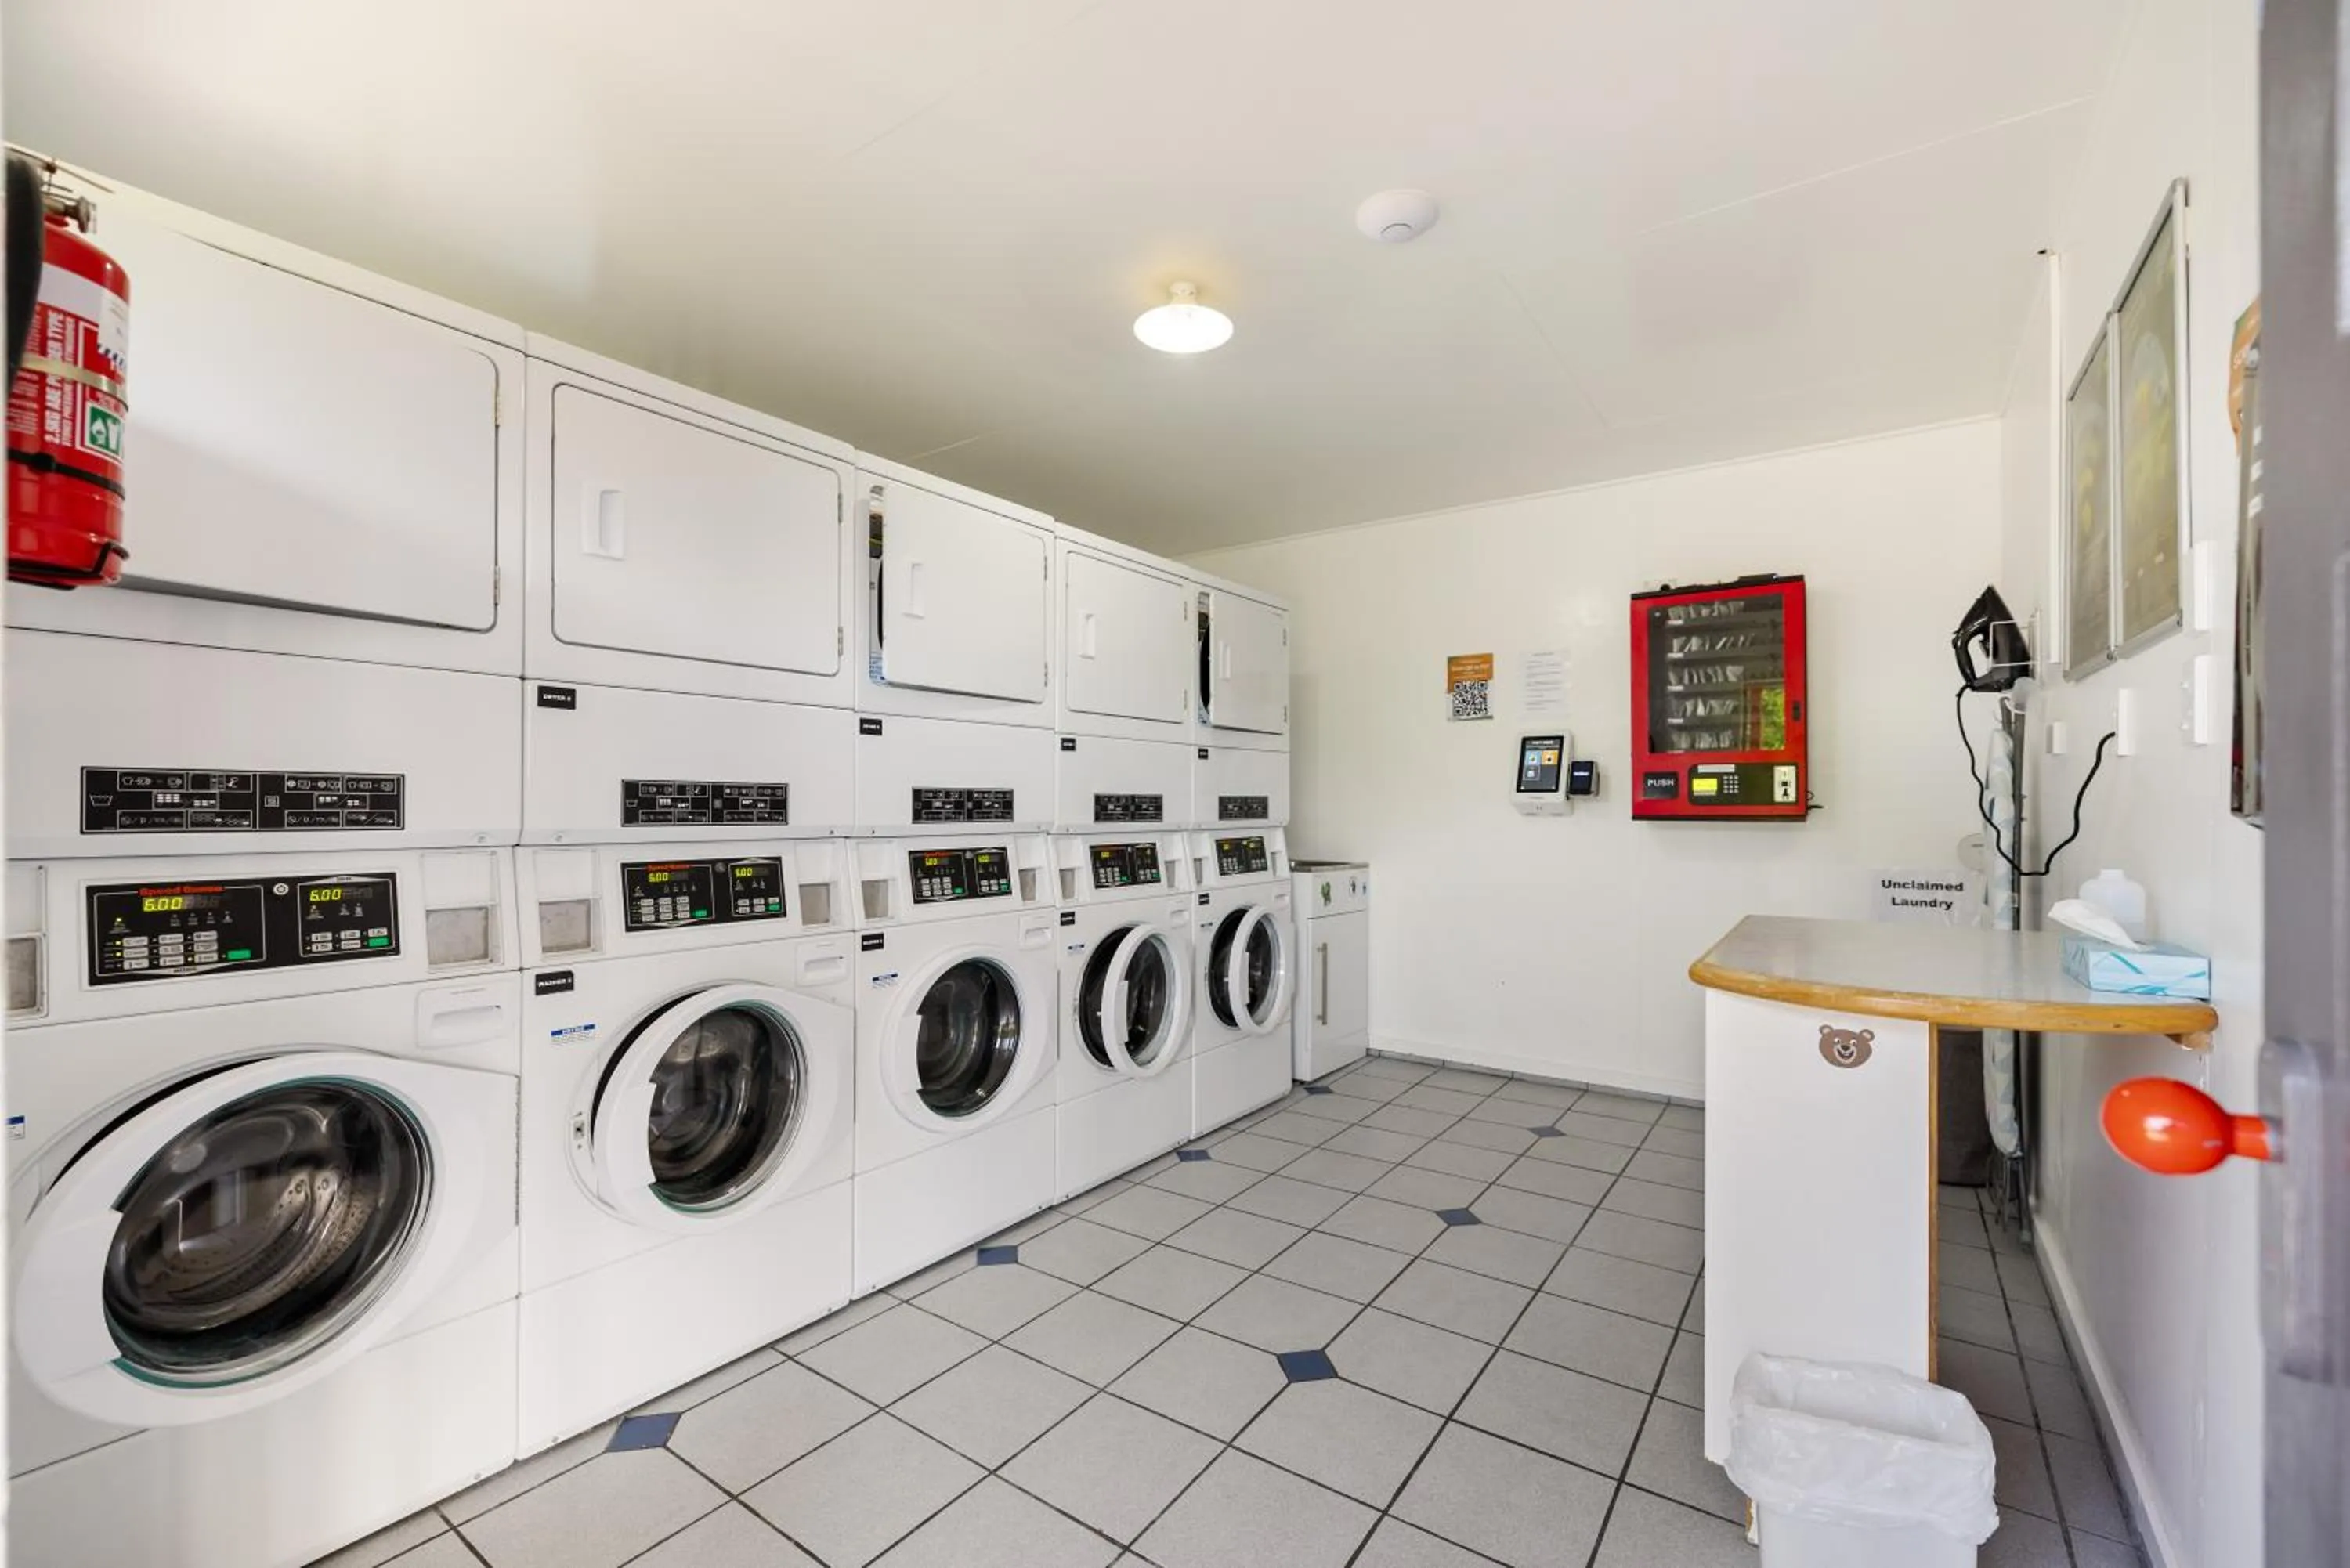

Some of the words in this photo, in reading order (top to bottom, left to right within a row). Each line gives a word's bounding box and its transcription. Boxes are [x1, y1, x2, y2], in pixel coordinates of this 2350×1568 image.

[47, 311, 63, 339] TYPE
[45, 341, 63, 386] PODER
[1647, 779, 1674, 787] PUSH
[1881, 880, 1964, 891] Unclaimed
[309, 889, 342, 901] 6.00
[143, 897, 183, 912] 6.00
[1892, 897, 1953, 911] Laundry
